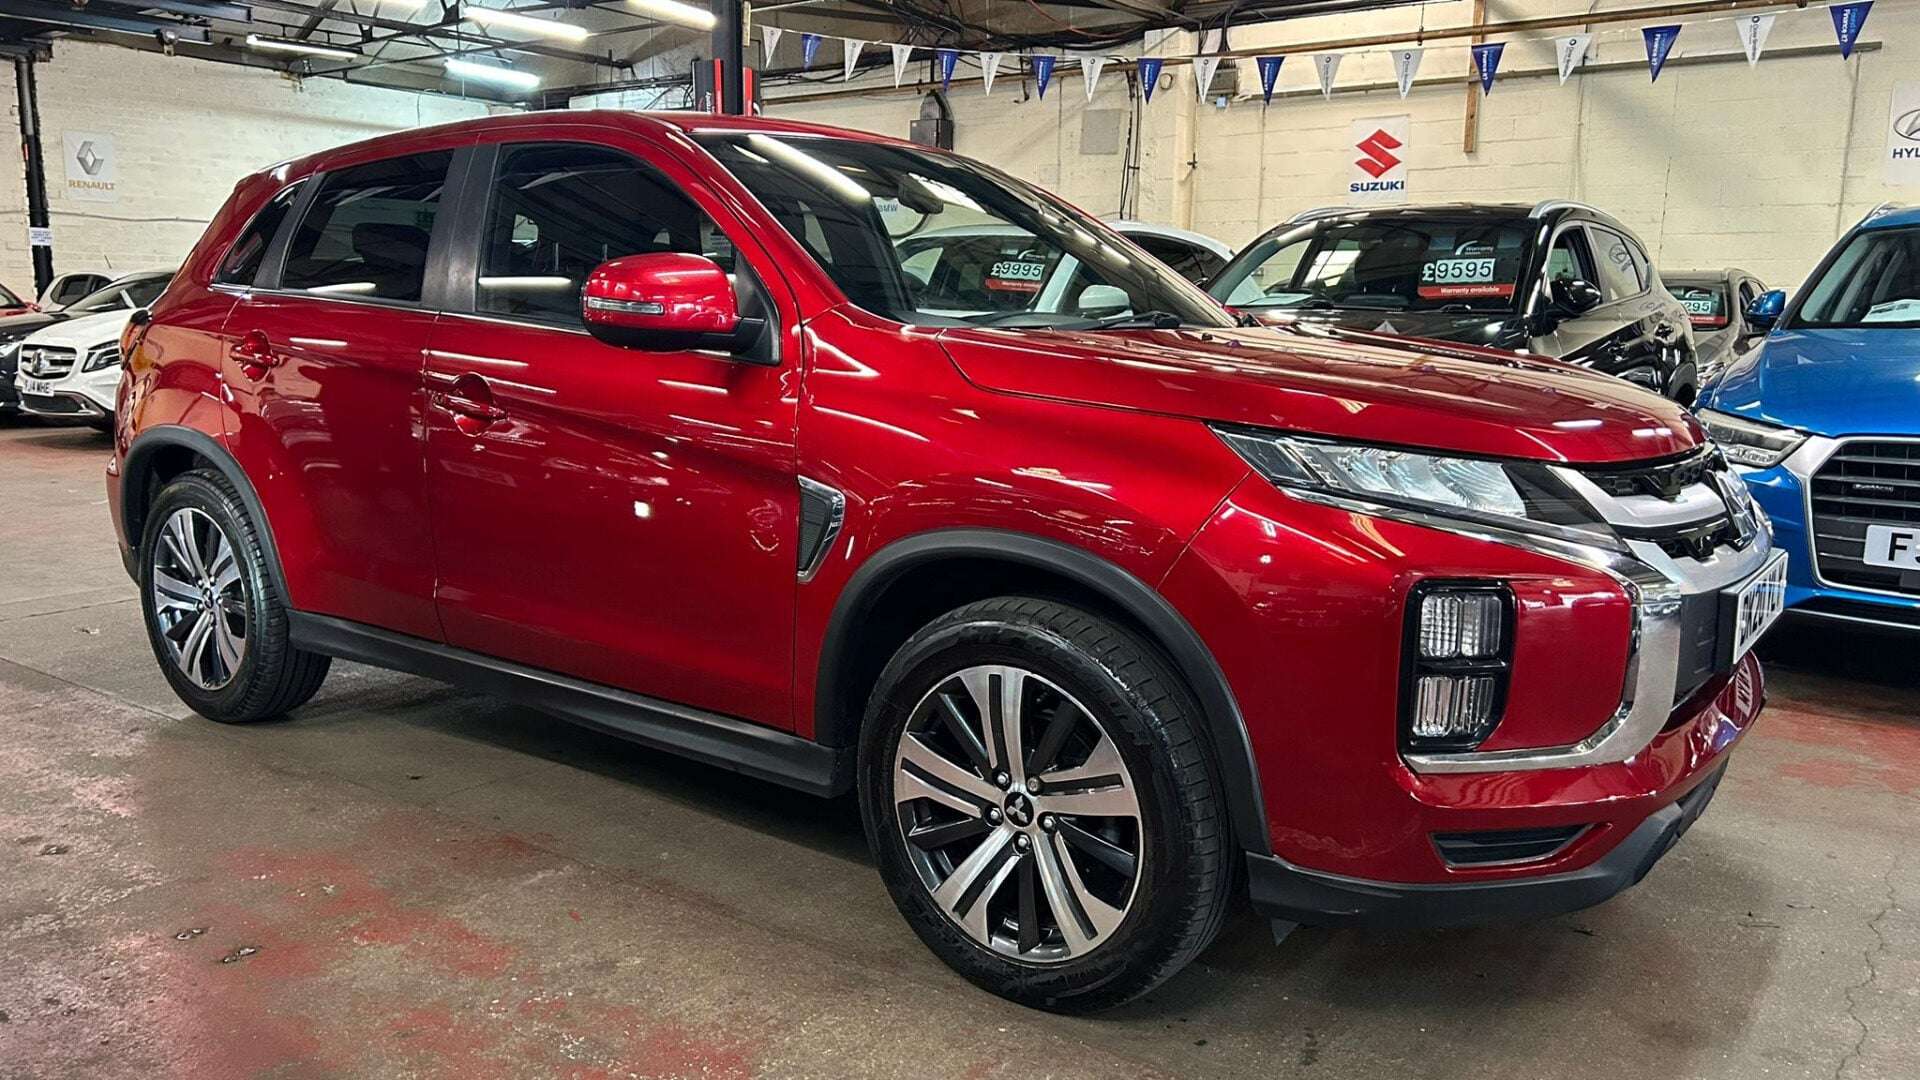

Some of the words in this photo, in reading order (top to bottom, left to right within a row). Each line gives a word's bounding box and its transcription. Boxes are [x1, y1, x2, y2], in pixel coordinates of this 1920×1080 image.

[1841, 9, 1850, 33] Finance
[68, 180, 115, 190] RENAULT
[1350, 180, 1404, 192] SUZUKI
[990, 261, 1042, 277] £9995
[1422, 261, 1492, 281] £9595
